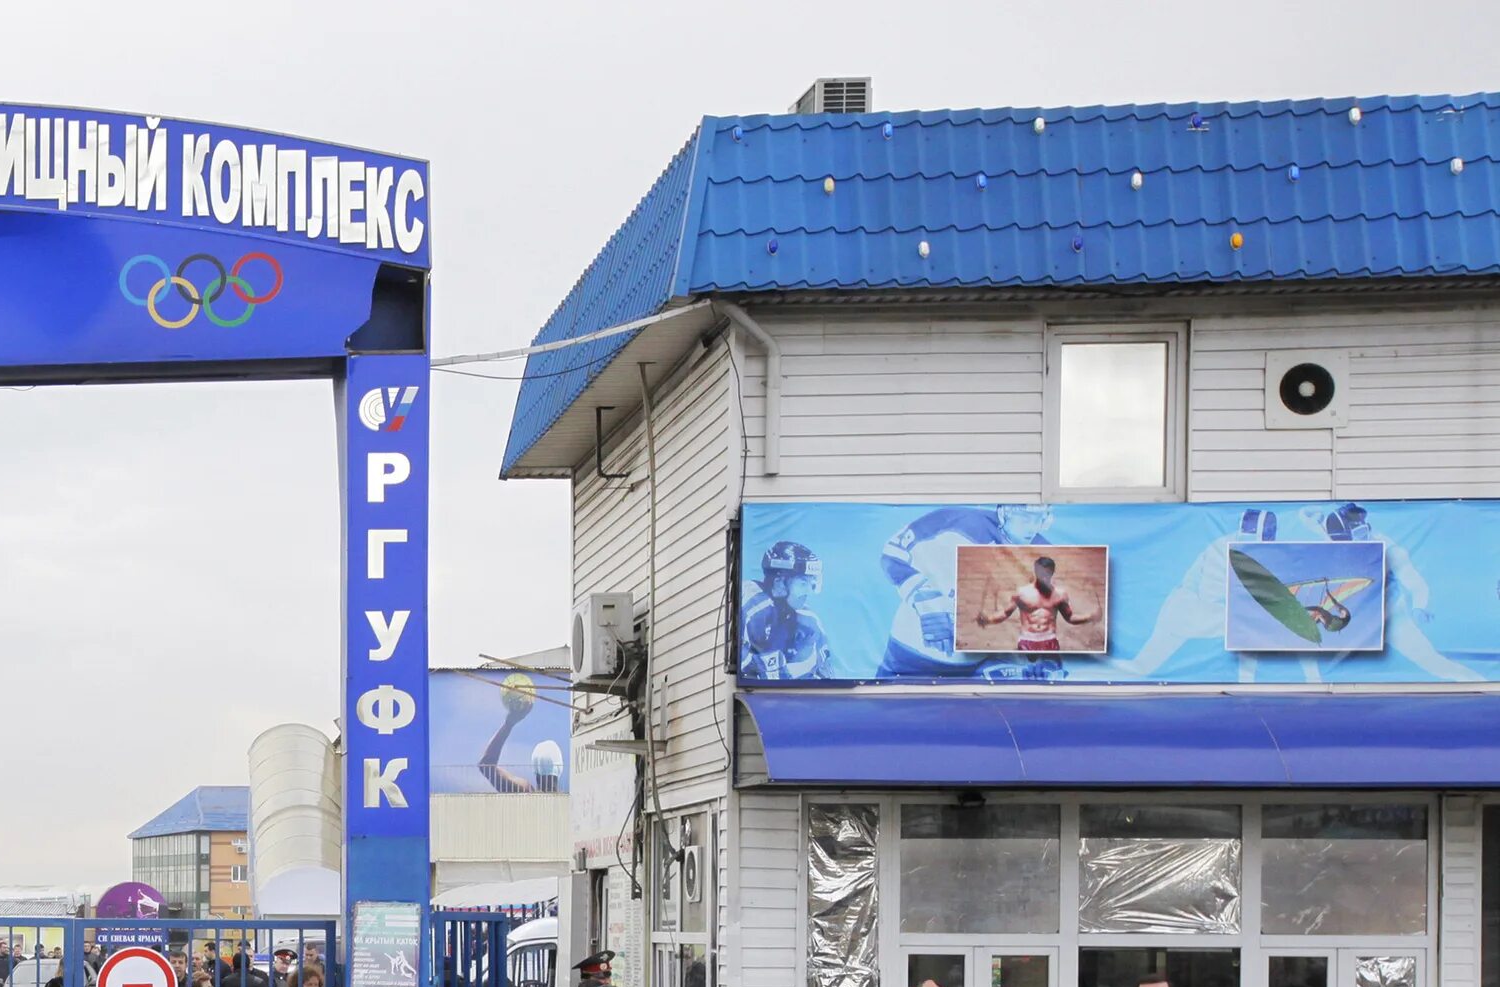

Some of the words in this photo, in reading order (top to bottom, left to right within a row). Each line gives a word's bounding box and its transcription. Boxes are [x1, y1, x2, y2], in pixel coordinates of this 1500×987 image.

[182, 132, 426, 254] КОМПЛЕКС
[97, 934, 136, 943] СИЕНЕВАЯ
[138, 935, 167, 943] ЯРМАРК
